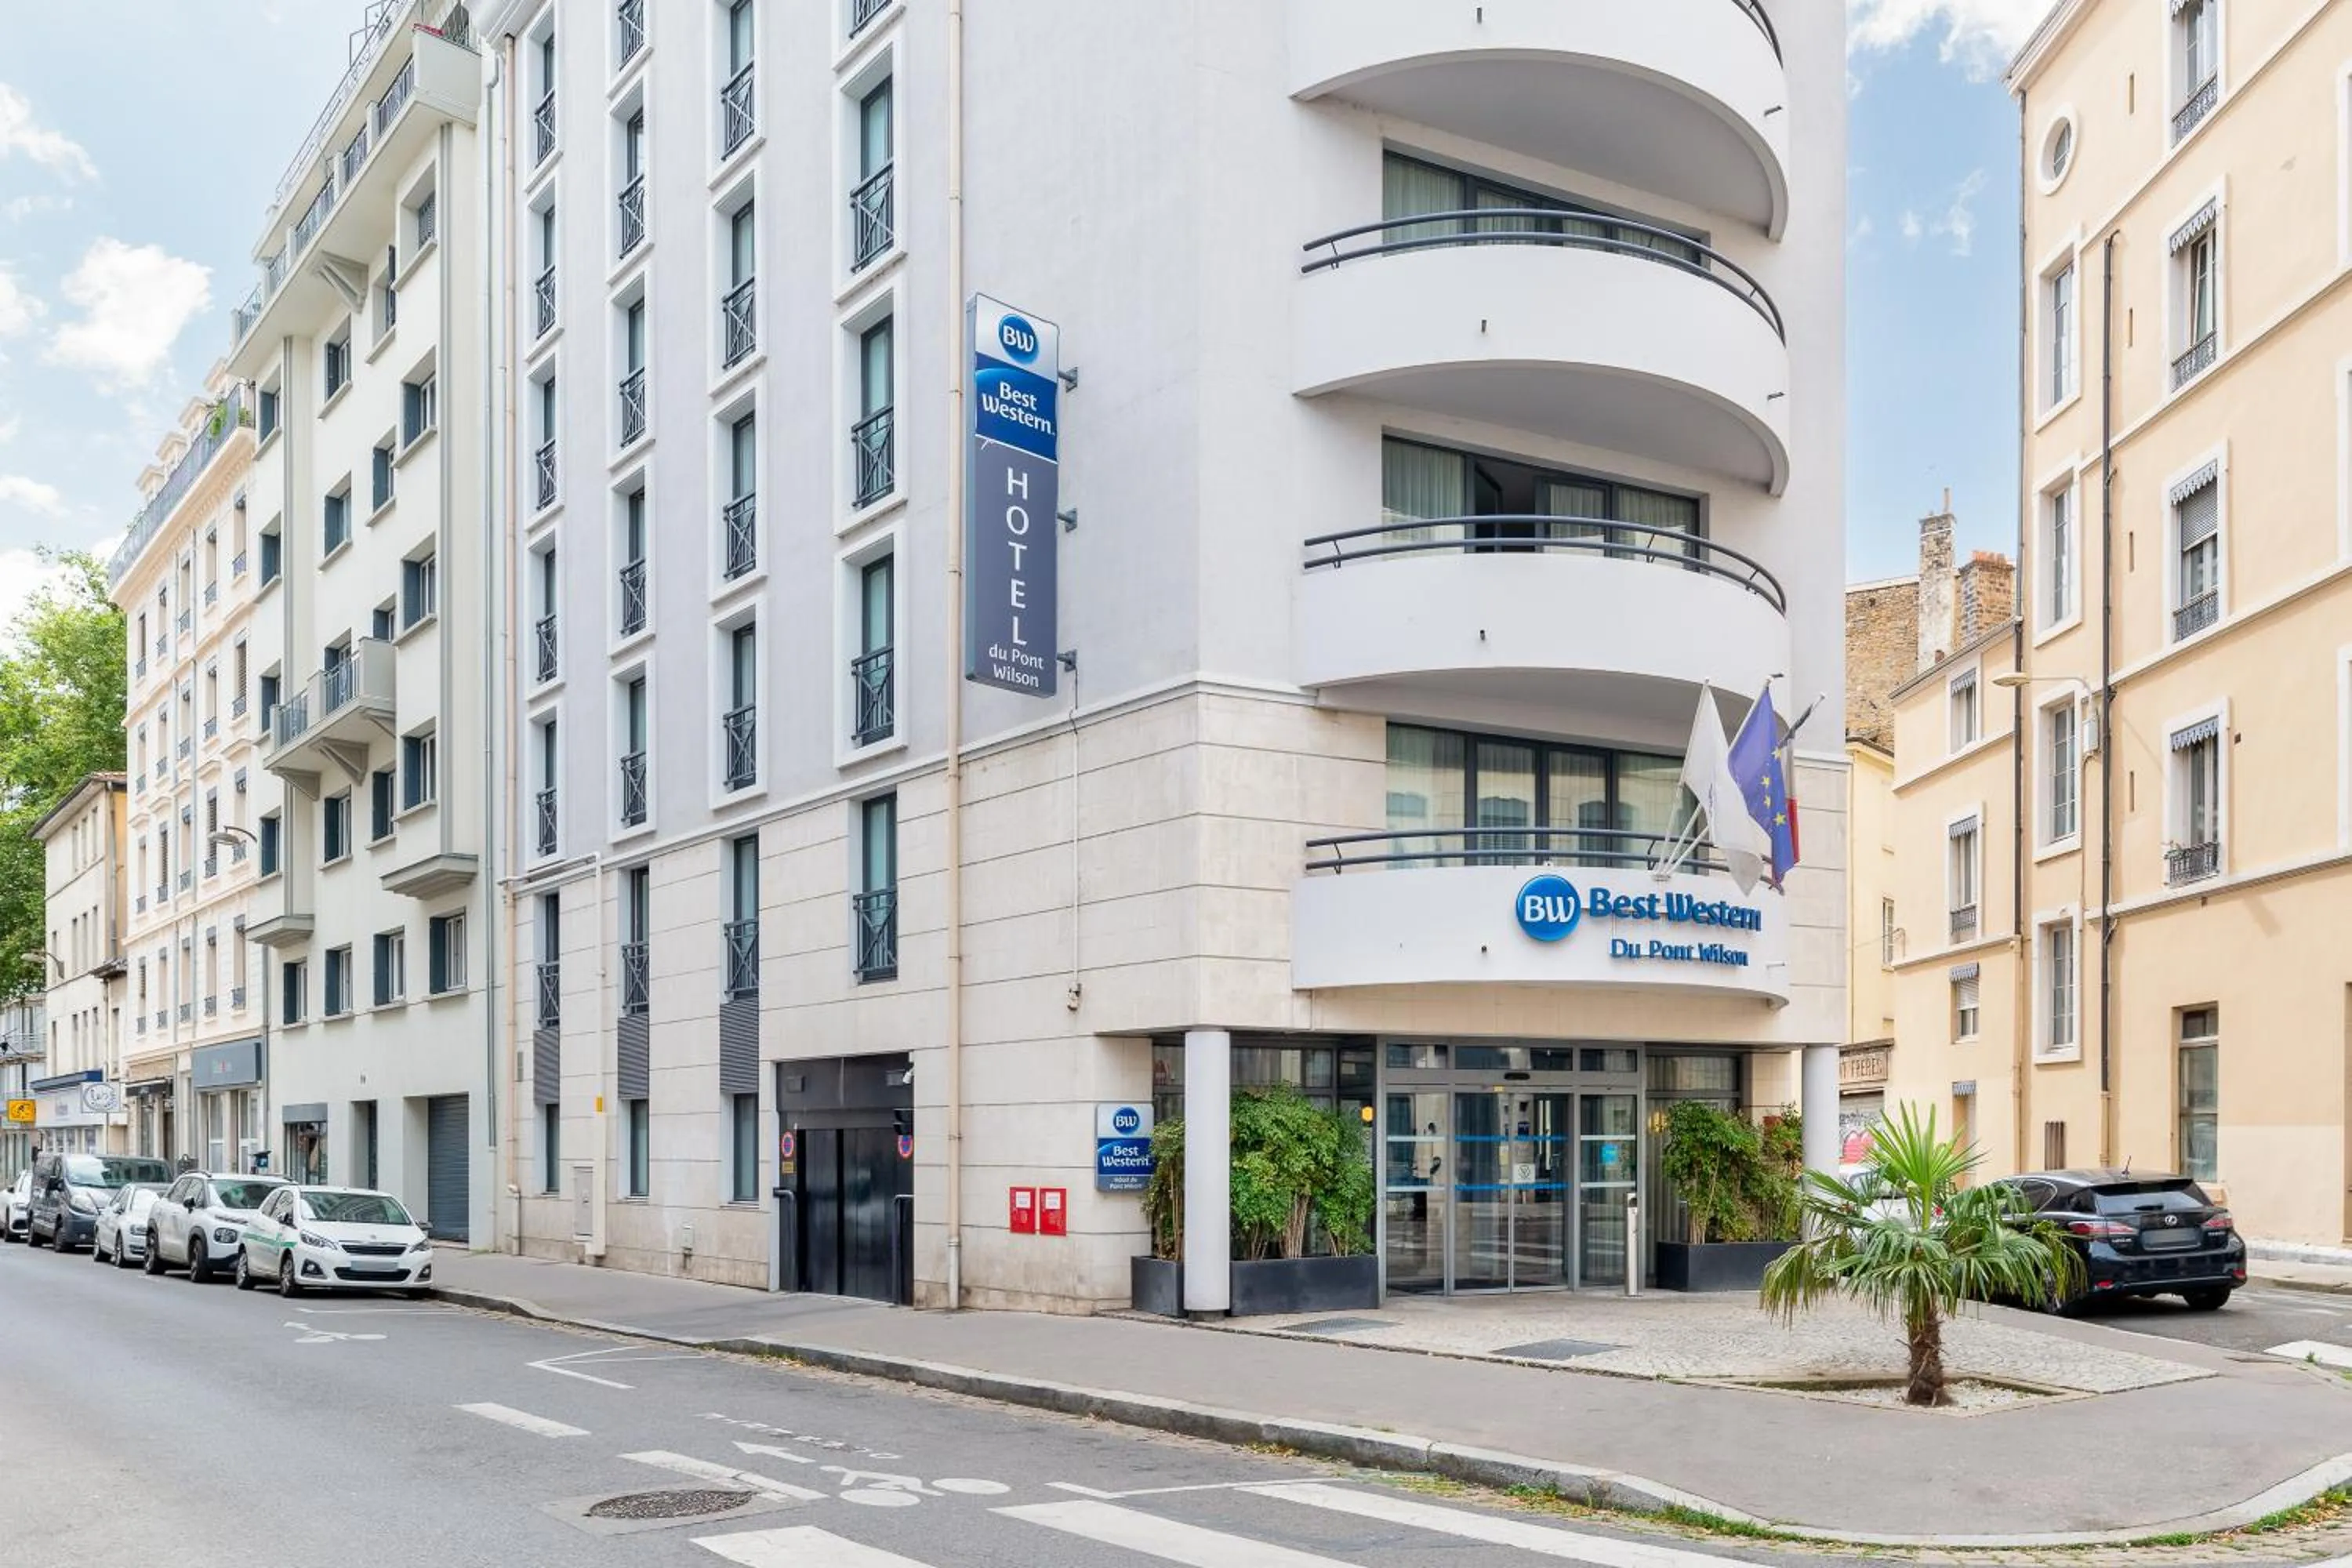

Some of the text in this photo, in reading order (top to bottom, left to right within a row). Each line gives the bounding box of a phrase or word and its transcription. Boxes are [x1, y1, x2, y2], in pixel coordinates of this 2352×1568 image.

[1003, 325, 1034, 352] BW
[1000, 382, 1037, 412] Best
[982, 393, 1052, 434] Western
[1006, 467, 1029, 646] HOTEL
[989, 644, 1044, 670] du Pont
[993, 664, 1040, 688] Wilson
[1524, 887, 1762, 932] BW Best Western
[1610, 938, 1749, 967] Du Pont Wilson
[1116, 1115, 1137, 1127] BW
[1102, 1156, 1149, 1167] Western
[1113, 1145, 1139, 1156] Best
